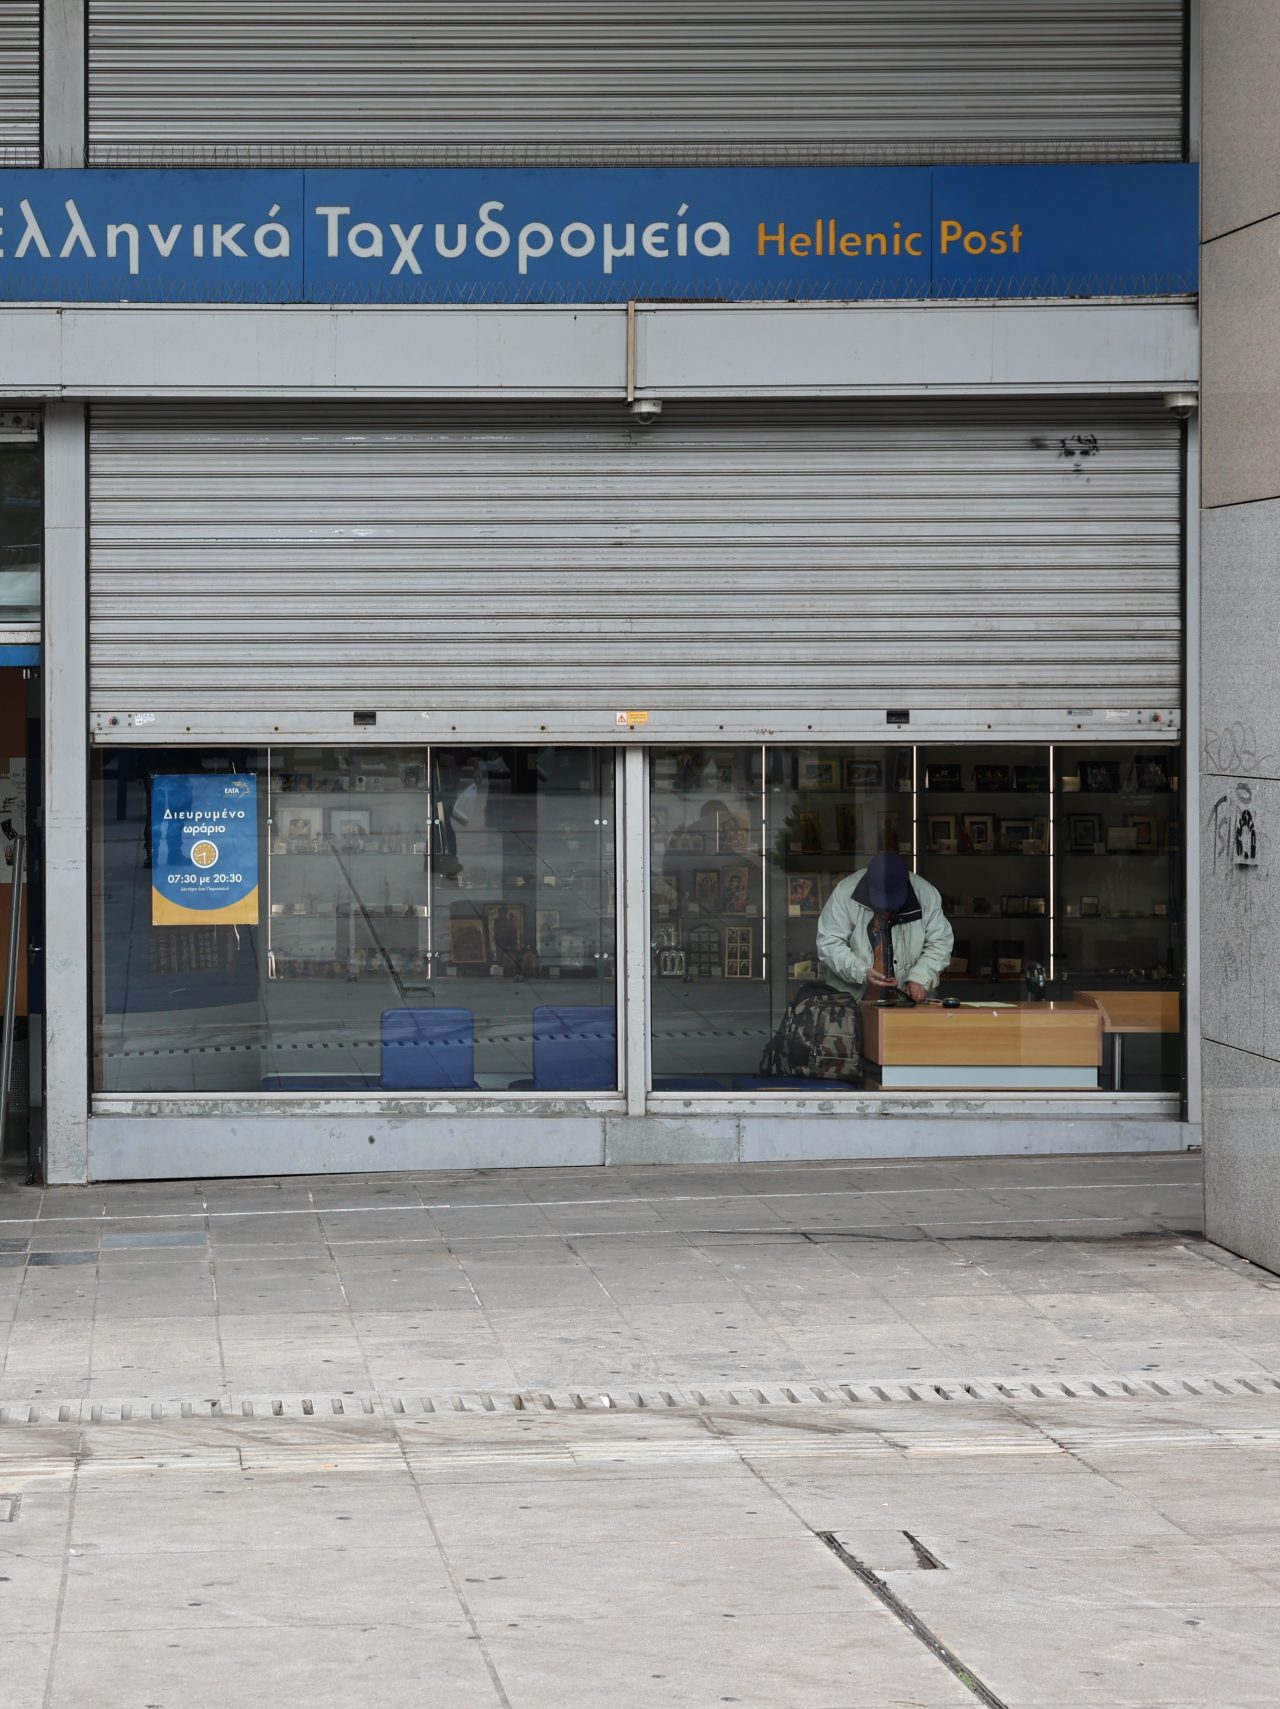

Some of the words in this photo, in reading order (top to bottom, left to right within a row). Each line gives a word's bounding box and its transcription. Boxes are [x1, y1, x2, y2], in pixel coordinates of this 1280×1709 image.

[315, 201, 731, 275] Ταχυδρομεία
[756, 218, 923, 258] Hellenic
[939, 219, 1023, 255] Post
[224, 787, 240, 795] ΕΛΤΑ
[163, 808, 245, 821] Διευρυμένο
[183, 822, 226, 837] ωράριο
[167, 874, 197, 884] 07:30
[200, 876, 211, 886] με
[213, 873, 242, 883] 20:30
